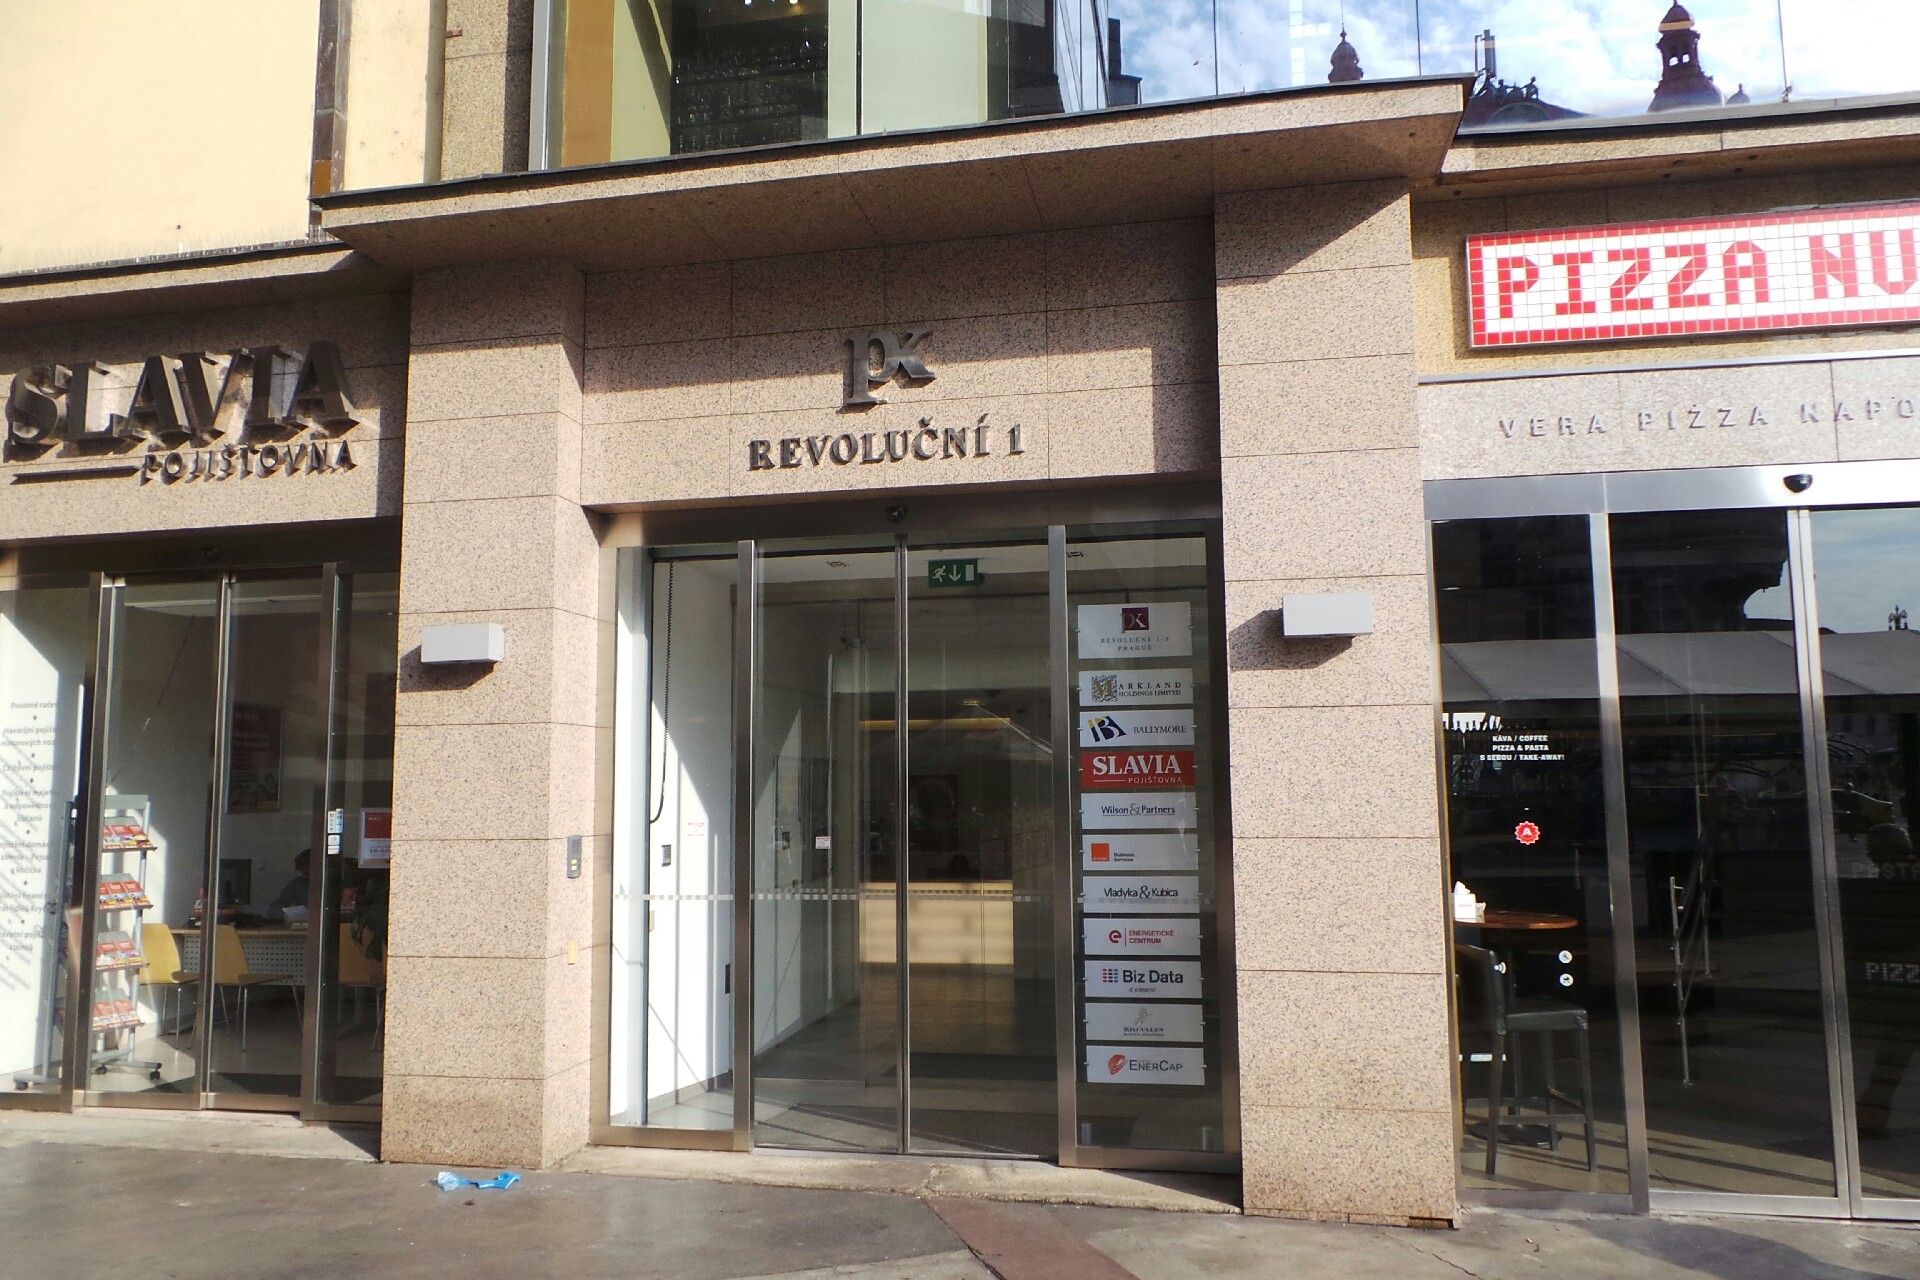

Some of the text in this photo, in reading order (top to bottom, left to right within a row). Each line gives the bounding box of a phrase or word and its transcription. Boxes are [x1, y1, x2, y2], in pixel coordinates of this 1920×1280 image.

[1496, 229, 1919, 319] PIZZA NU
[7, 341, 354, 445] SLAVIA
[1500, 395, 1917, 438] VERA PIZZA NAPO
[748, 413, 1025, 471] REVOLUČNÍ 1
[1133, 725, 1187, 734] BALLYMORE
[1092, 754, 1182, 776] SLAVIA
[1101, 804, 1129, 815] Wilson
[1141, 804, 1176, 815] Partners
[1104, 885, 1179, 899] Vladyka & Kubica
[1123, 969, 1184, 984] Biz Data
